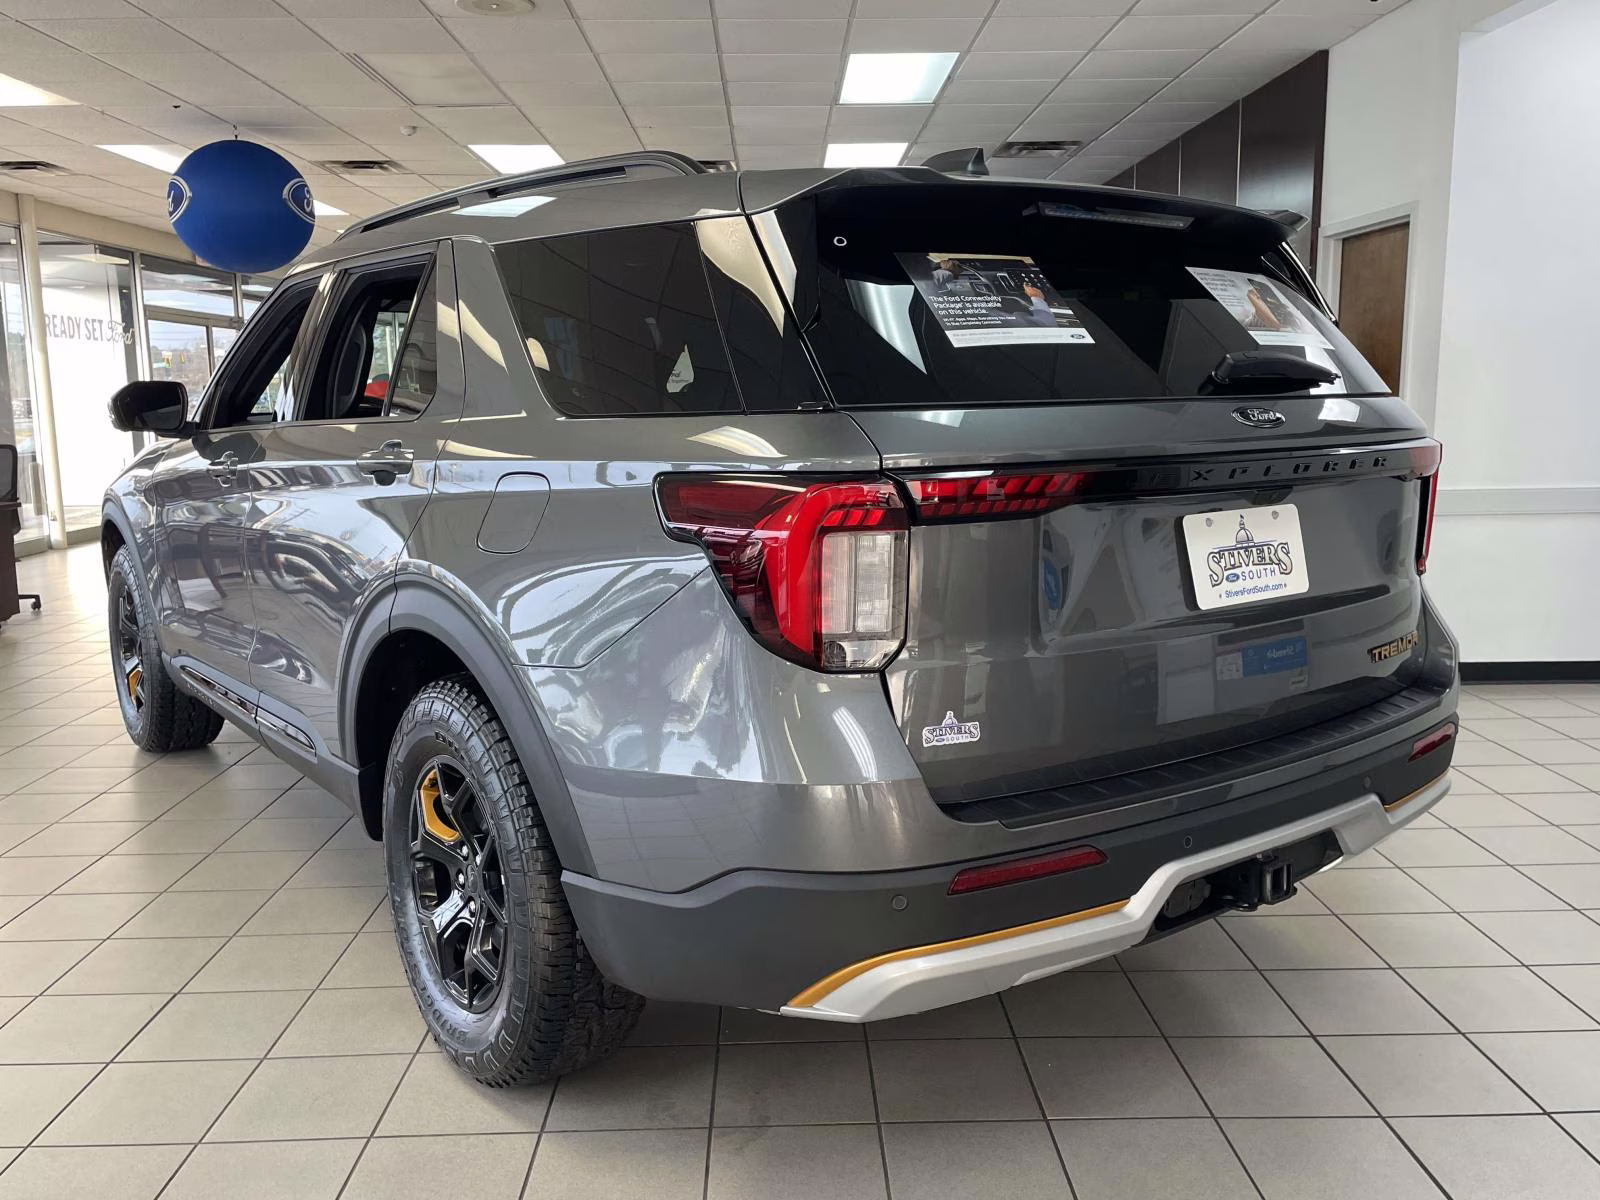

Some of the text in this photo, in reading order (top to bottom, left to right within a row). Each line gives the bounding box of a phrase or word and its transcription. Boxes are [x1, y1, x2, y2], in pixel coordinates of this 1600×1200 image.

[960, 295, 1002, 303] Connectivity
[44, 313, 135, 345] READY SET Ford
[1248, 408, 1277, 420] Ford
[1150, 456, 1387, 483] EXPLORER
[1207, 542, 1293, 588] STIVERS
[1241, 567, 1276, 581] SOUTH
[1225, 583, 1283, 598] StiversFordSouth.com
[1369, 630, 1419, 663] TREMOR
[924, 724, 978, 744] STIVERS
[945, 734, 970, 742] SOUTH
